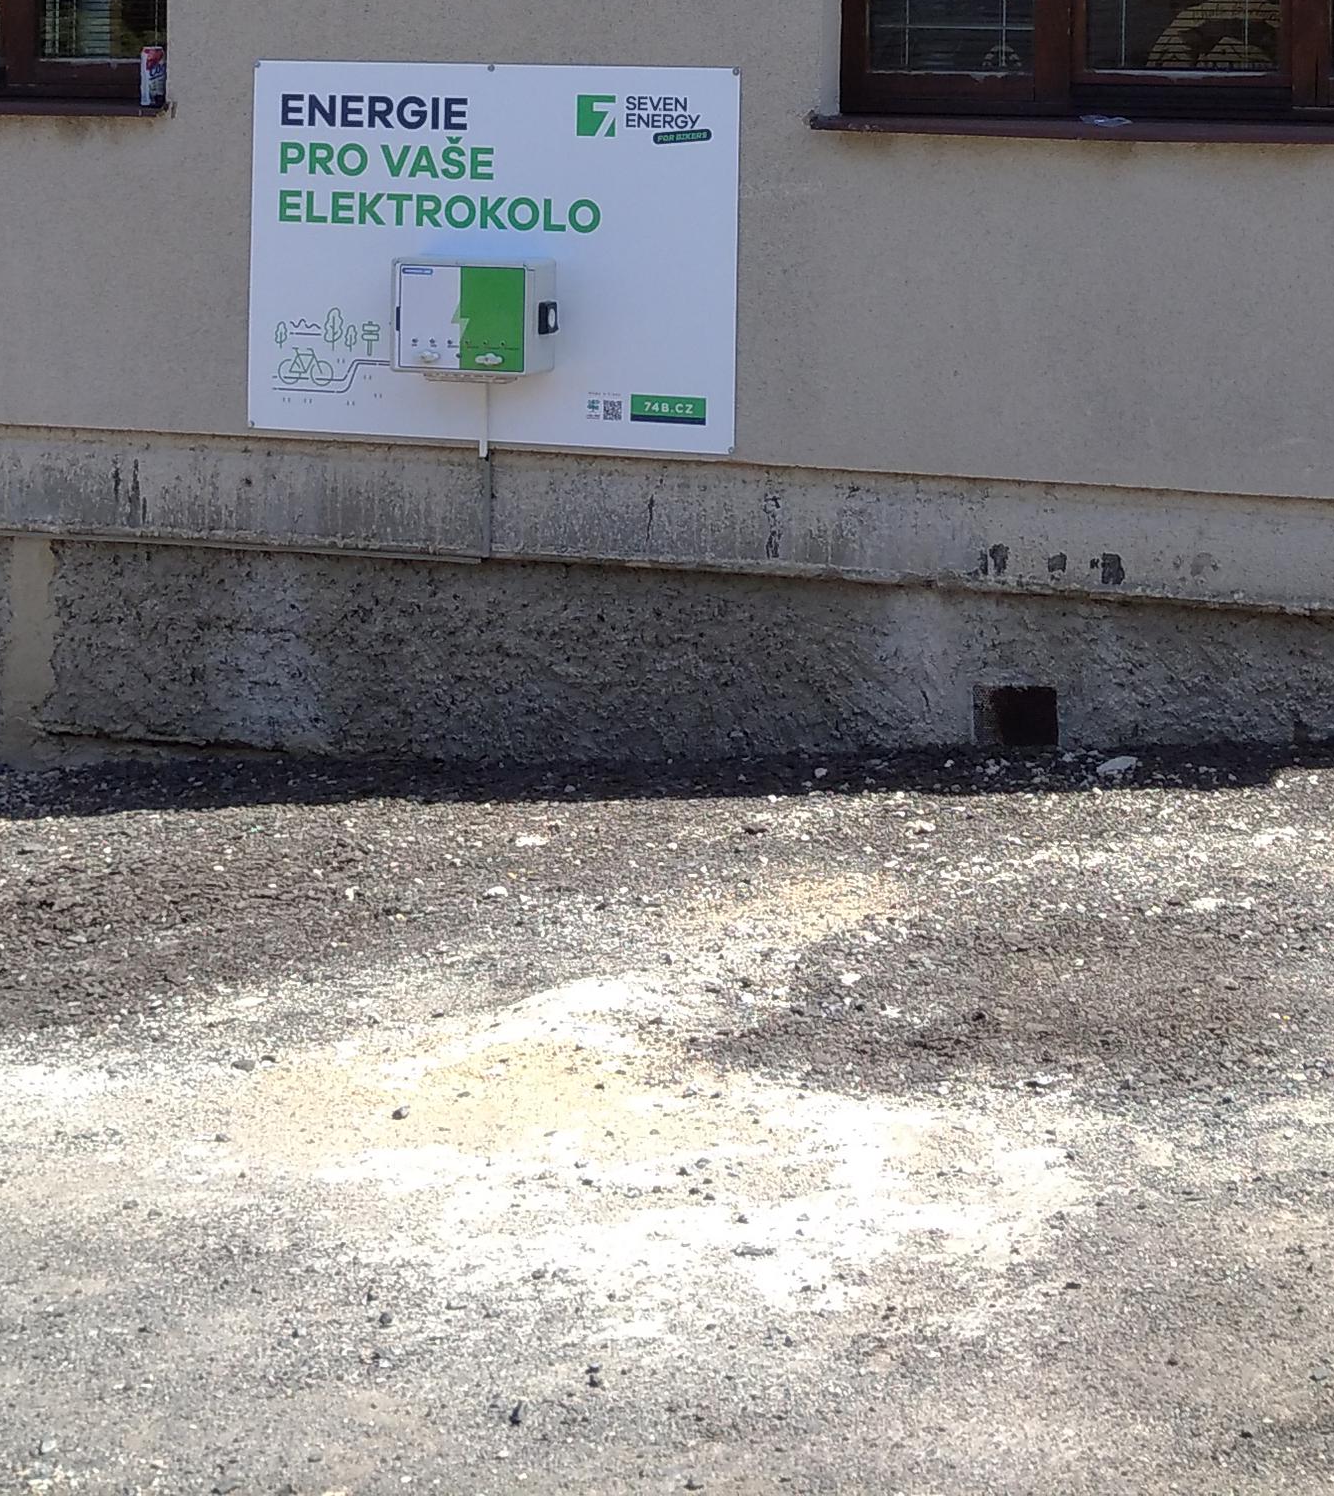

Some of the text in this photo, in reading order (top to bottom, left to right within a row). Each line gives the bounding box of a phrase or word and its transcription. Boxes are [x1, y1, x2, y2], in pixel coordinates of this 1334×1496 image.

[280, 93, 468, 131] ENERGIE
[625, 112, 701, 130] ENERGY
[657, 134, 675, 143] FOR
[279, 135, 495, 181] PRO VAŠE
[278, 189, 601, 234] ELEKTROKOLO
[643, 401, 694, 414] 74B.CZ
